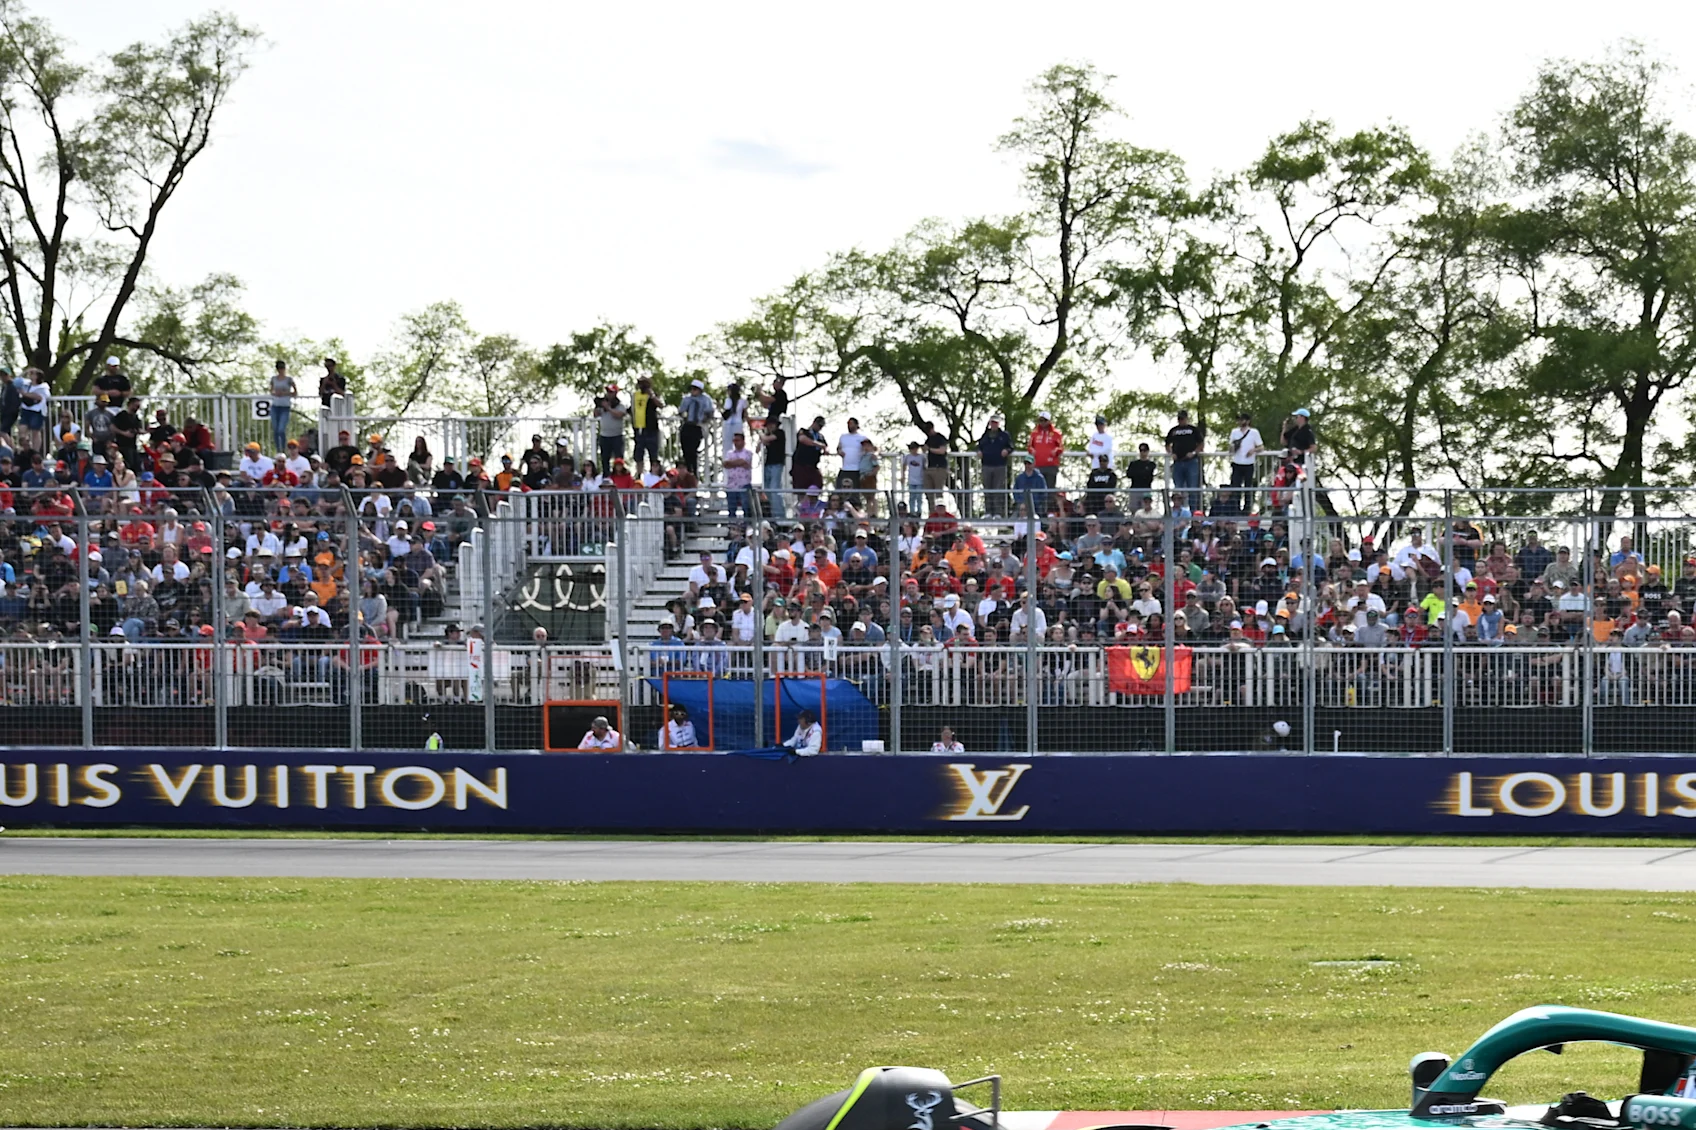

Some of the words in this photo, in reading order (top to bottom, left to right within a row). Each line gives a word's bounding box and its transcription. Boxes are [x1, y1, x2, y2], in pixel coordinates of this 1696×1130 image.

[256, 400, 270, 417] 8
[150, 763, 508, 810] VUITTON
[1429, 1104, 1478, 1114] aramco
[1628, 1104, 1683, 1126] BOSS
